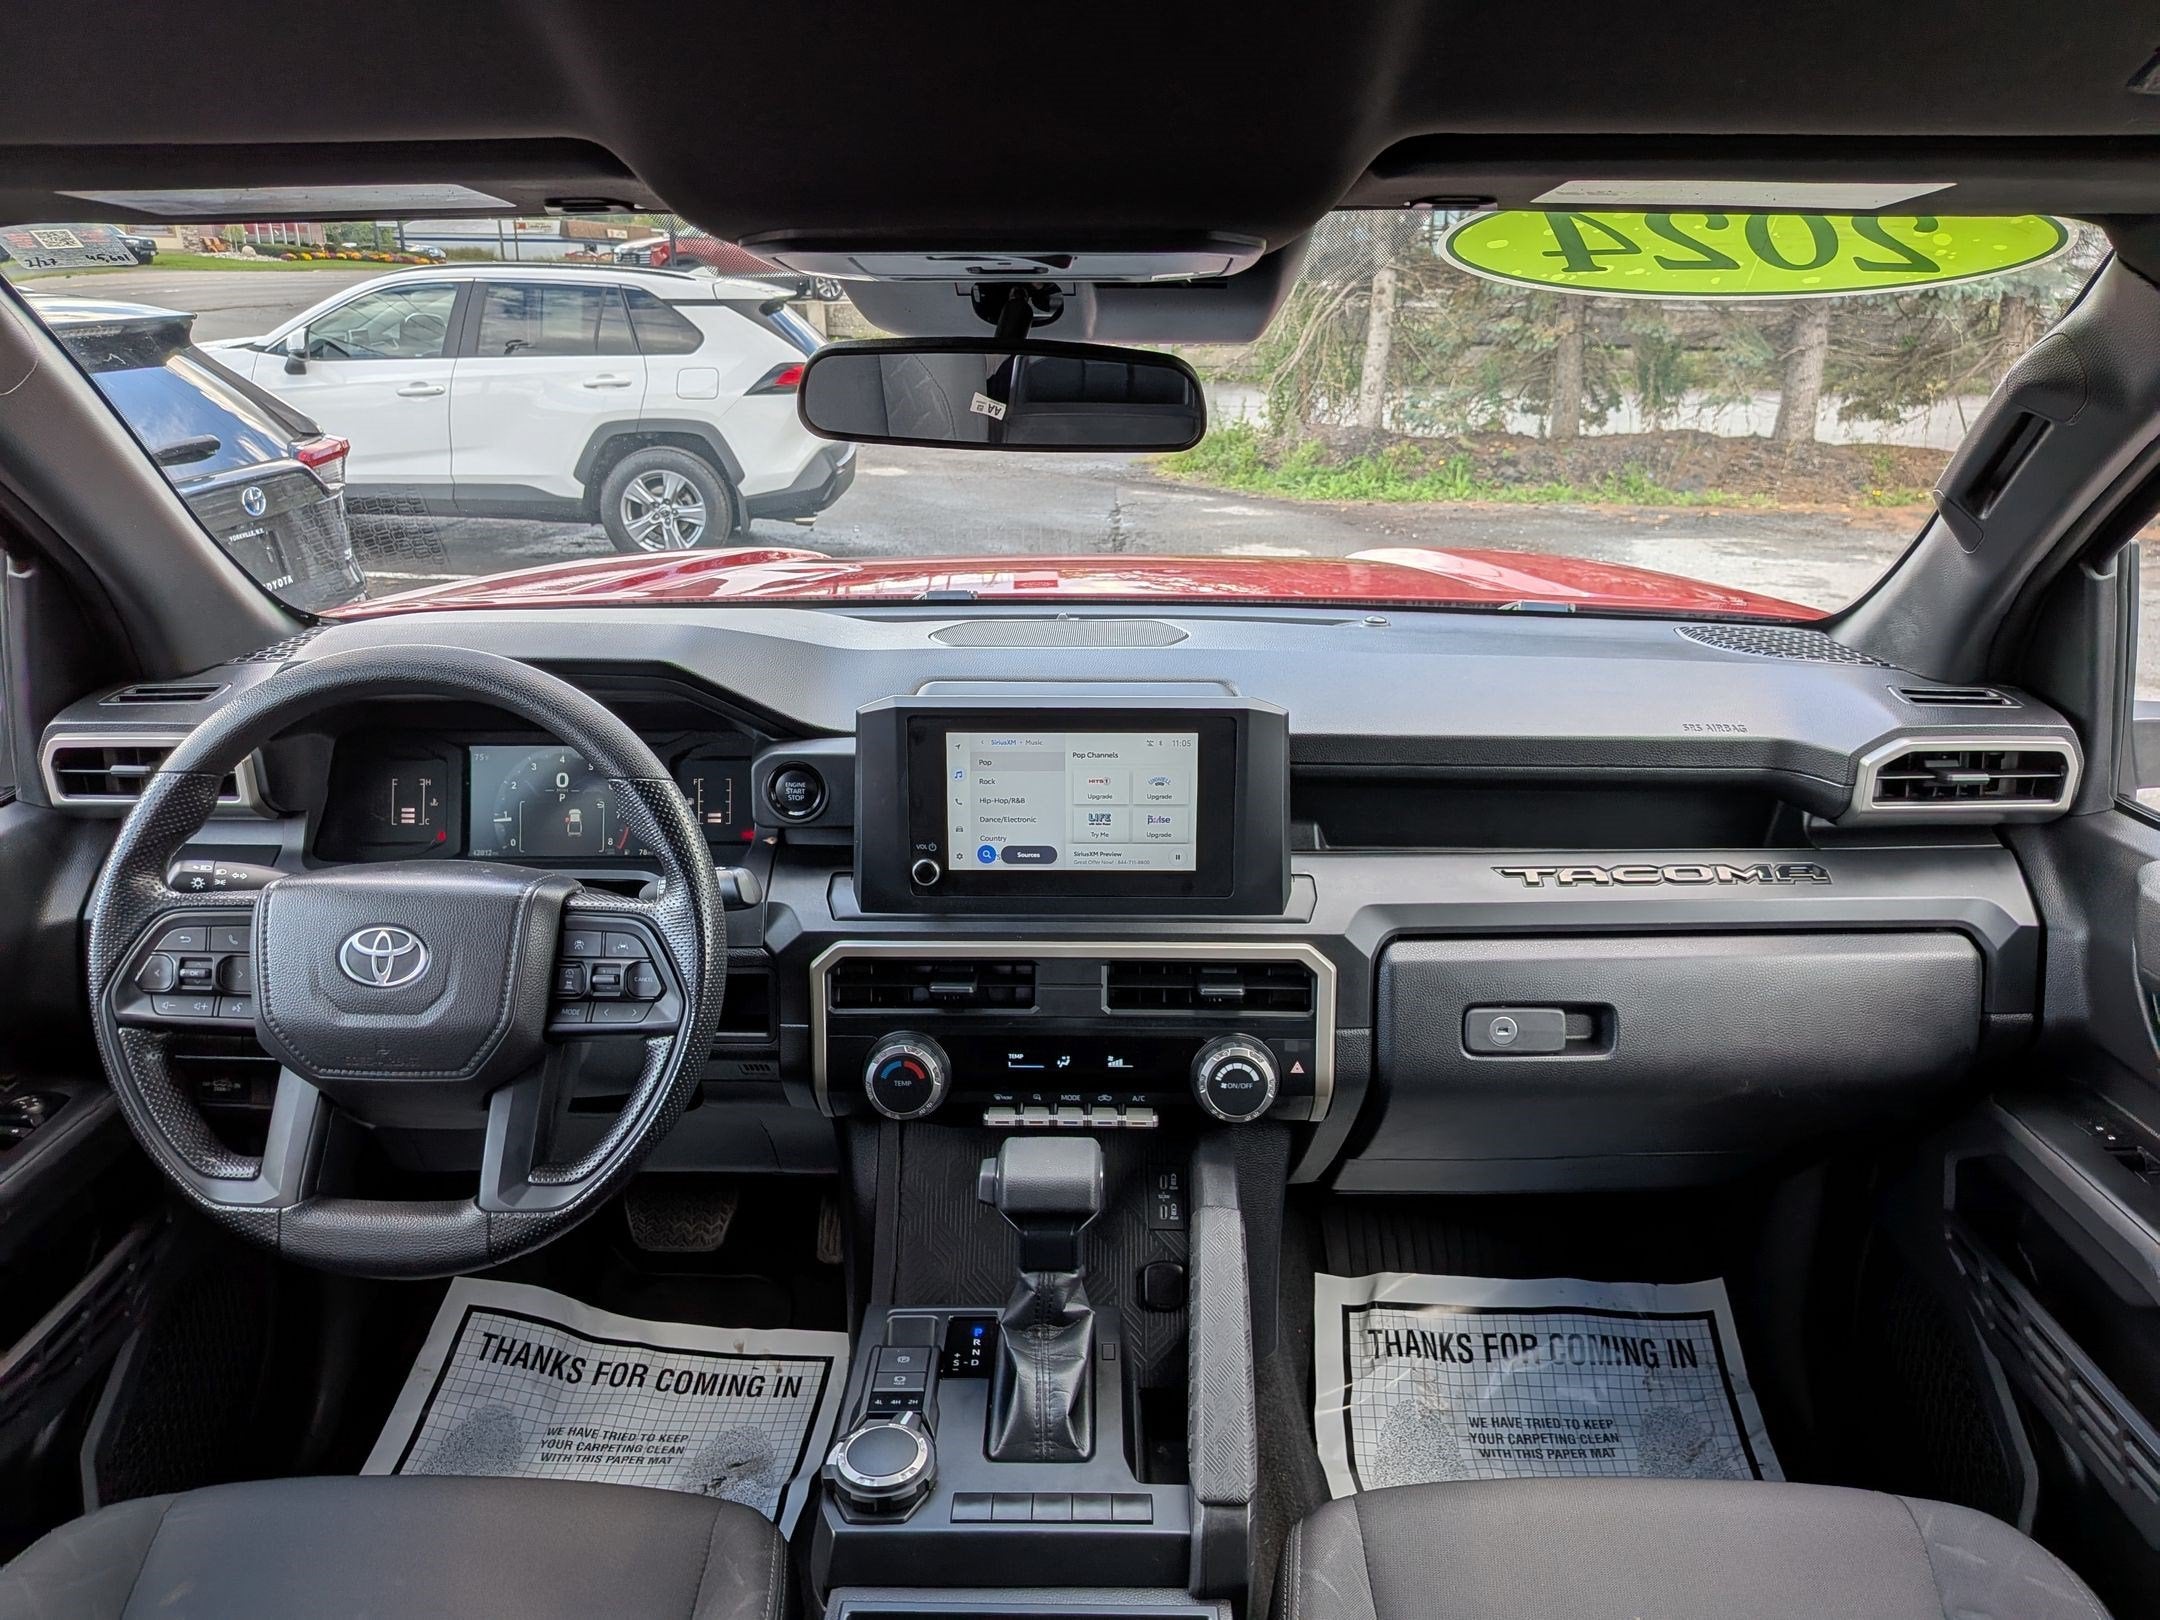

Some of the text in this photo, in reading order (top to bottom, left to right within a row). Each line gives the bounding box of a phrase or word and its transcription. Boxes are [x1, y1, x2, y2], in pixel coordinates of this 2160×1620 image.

[263, 575, 293, 591] OYOTA
[1705, 723, 1749, 733] AIRBAG
[1172, 739, 1191, 747] 11:05
[559, 755, 566, 764] 4
[1072, 751, 1119, 759] Pop Channels
[530, 763, 538, 771] 3
[588, 763, 594, 771] 5
[978, 759, 992, 767] Pop
[555, 772, 570, 788] 0
[510, 781, 518, 790] 2
[559, 793, 566, 802] P
[979, 797, 1026, 805] Hip-Hop/R&B
[510, 838, 517, 847] 0
[607, 837, 614, 846] 8
[979, 834, 1007, 843] Country
[1016, 851, 1041, 859] Sources
[1490, 863, 1832, 888] TACOMA
[561, 1008, 581, 1016] MODE
[1131, 1094, 1146, 1102] A/C
[974, 1328, 983, 1337] P
[973, 1338, 981, 1346] R
[1368, 1328, 1699, 1369] THANKS FOR COMING IN
[477, 1332, 803, 1399] THANKS FOR COMING IN
[952, 1359, 960, 1367] S
[1468, 1416, 1615, 1431] WE HAVE TRIED TO KEEP
[546, 1427, 690, 1444] WE HAVE TRIED TO KEEP
[1469, 1431, 1620, 1446] YOUR CARPETING CLEAN
[540, 1439, 686, 1455] YOUR CARPETING CLEAN
[540, 1452, 675, 1466] WITH THIS PAPER MAT
[1479, 1448, 1617, 1461] WITH THIS PAPER MAT
